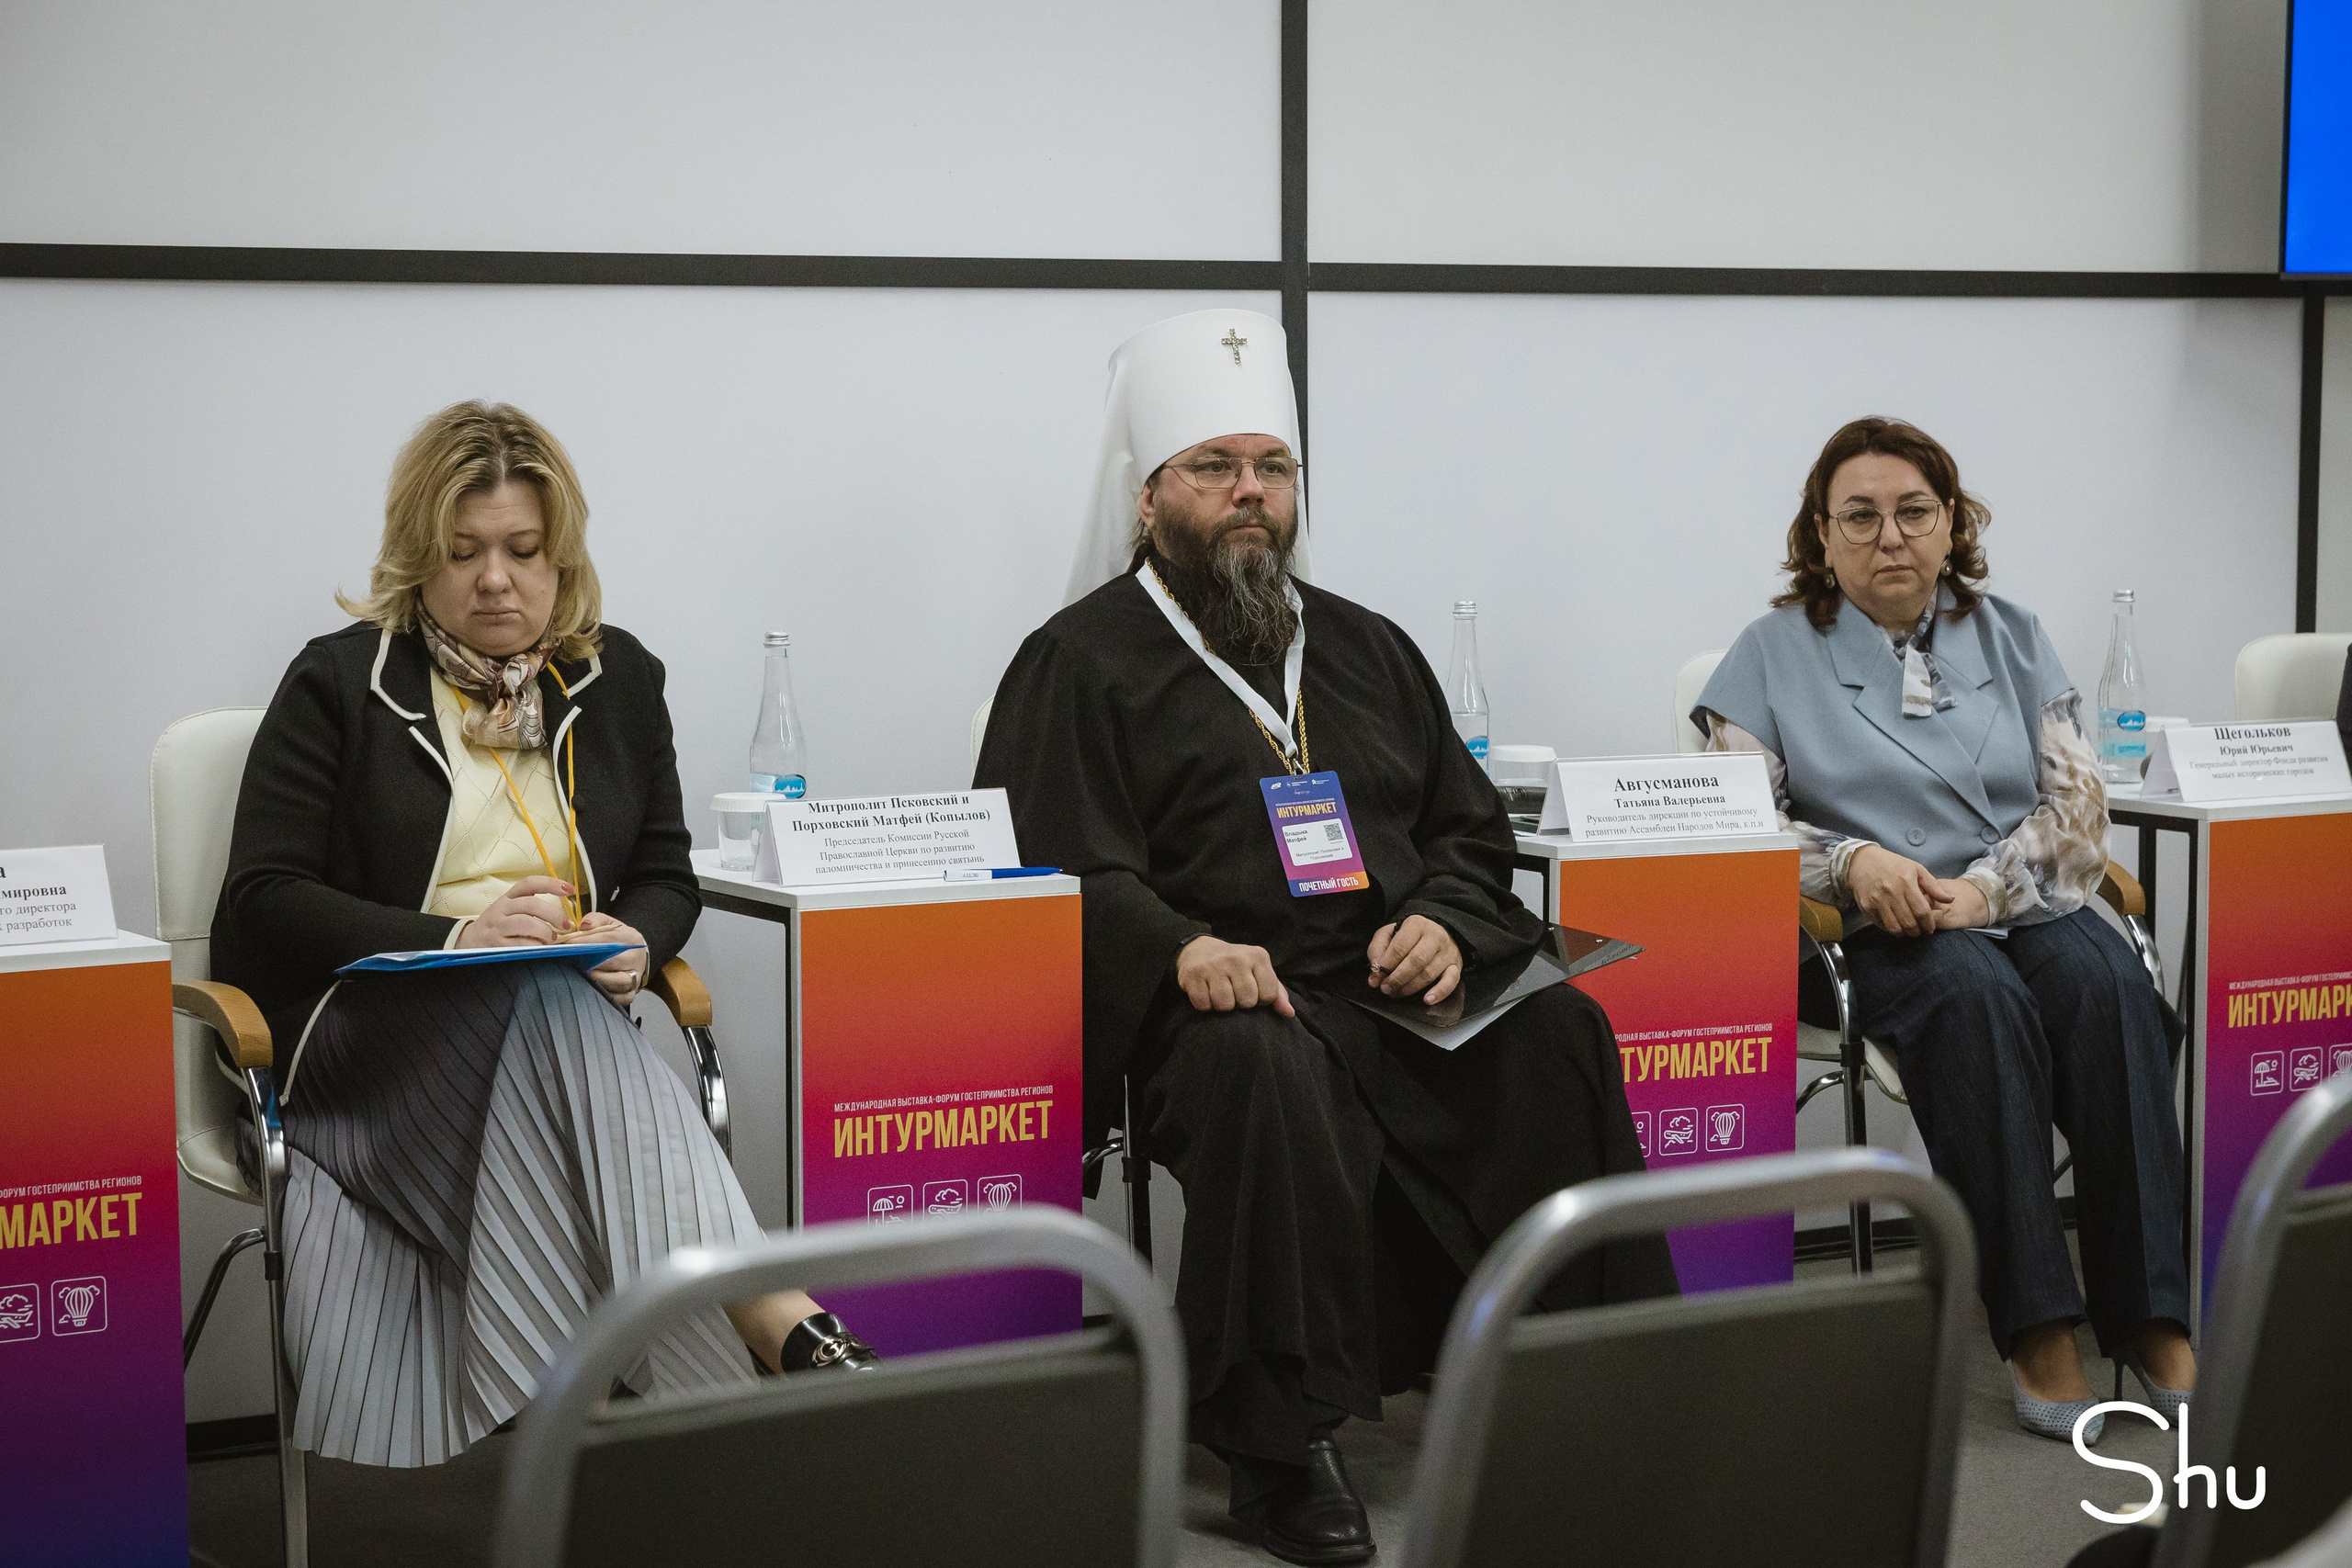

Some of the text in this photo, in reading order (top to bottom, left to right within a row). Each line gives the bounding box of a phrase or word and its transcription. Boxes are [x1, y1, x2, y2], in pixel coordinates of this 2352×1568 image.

[2214, 727, 2291, 741] Щегольков
[2220, 744, 2293, 757] Юрий Юрьевич
[1614, 776, 1719, 795] Авгусманова
[808, 795, 970, 815] Митрополит Псковский и
[1276, 802, 1337, 818] ИНТУРМАРКЕТ
[1614, 795, 1725, 808] Татьяна Валерьевна
[792, 809, 991, 833] Порховский Матфей (Копылов)
[1587, 814, 1646, 825] Руководитель
[1648, 812, 1689, 822] дирекции
[1703, 808, 1758, 820] устойчивому
[824, 829, 970, 848] Председатель Комиссии Русской
[1585, 828, 1626, 839] развитию
[1629, 824, 1676, 834] Ассамблеи
[1678, 822, 1713, 833] Народов
[820, 843, 976, 862] Православной Церкви по развитию
[815, 862, 883, 874] паломничества
[892, 856, 946, 869] принесению
[948, 854, 985, 866] святынь
[0, 886, 67, 901] мировна
[1298, 876, 1359, 892] ПОЧЕТНЫЙ ГОСТЬ
[16, 901, 76, 916] директора
[6, 917, 72, 933] разработок
[1639, 1029, 1692, 1041] ВЫСТАВКА-ФОРУМ
[1693, 1025, 1744, 1037] ГОСТЕПРИИМСТВА
[1745, 1022, 1773, 1033] РЕГИОНОВ
[1620, 1037, 1772, 1083] ТУРМАРКЕТ
[834, 1085, 1054, 1112] МЕЖДУНАРОДНАЯ ВЫСТАВКА-ФОРУМ ГОСТЕПРИИМСТВА РЕГИОНОВ
[834, 1100, 1054, 1158] ИНТУРМАРКЕТ
[27, 1180, 100, 1196] ГОСТЕПРИИМСТВА
[102, 1176, 141, 1189] РЕГИОНОВ
[0, 1192, 142, 1250] МАРКЕТ
